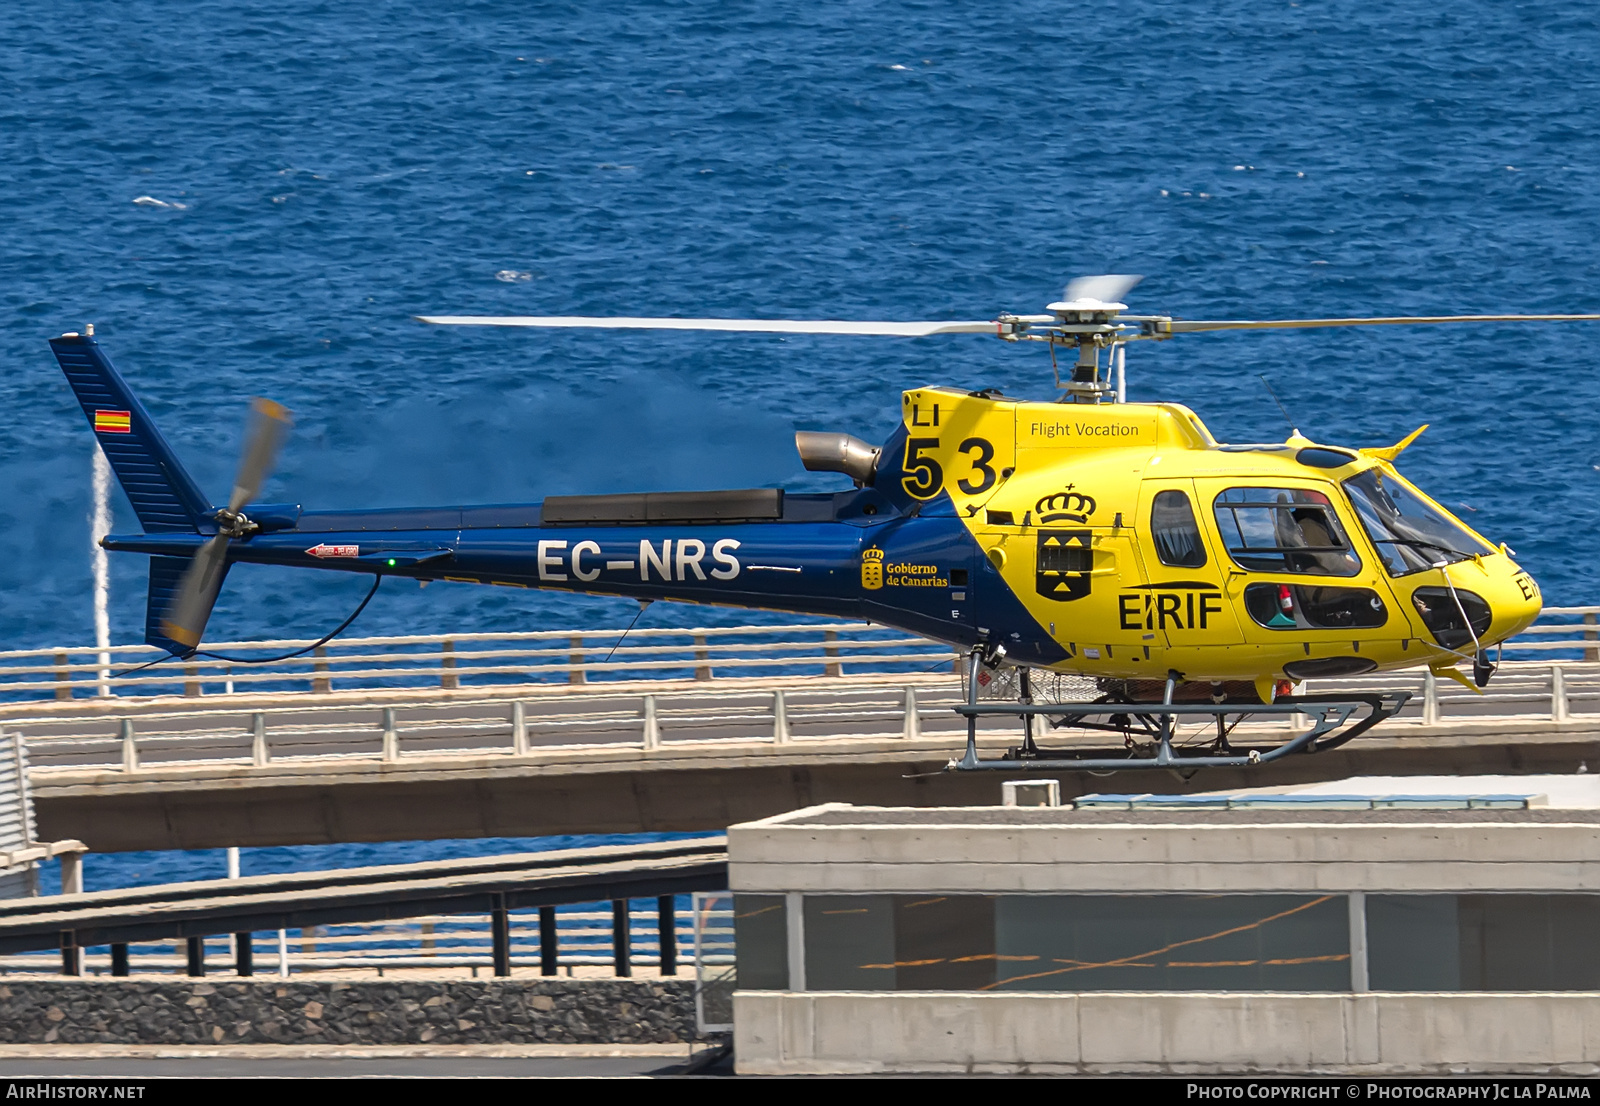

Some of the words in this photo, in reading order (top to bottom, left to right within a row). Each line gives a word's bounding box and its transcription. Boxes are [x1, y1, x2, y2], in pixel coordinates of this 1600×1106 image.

[912, 403, 940, 427] LI
[1031, 422, 1070, 439] Flight
[1075, 422, 1139, 437] Vocation
[902, 437, 996, 500] 53
[537, 538, 741, 582] EC-NRS
[886, 562, 938, 575] Gobierno
[886, 574, 900, 586] de
[900, 575, 948, 587] Canarias
[1118, 592, 1222, 630] EIRIF
